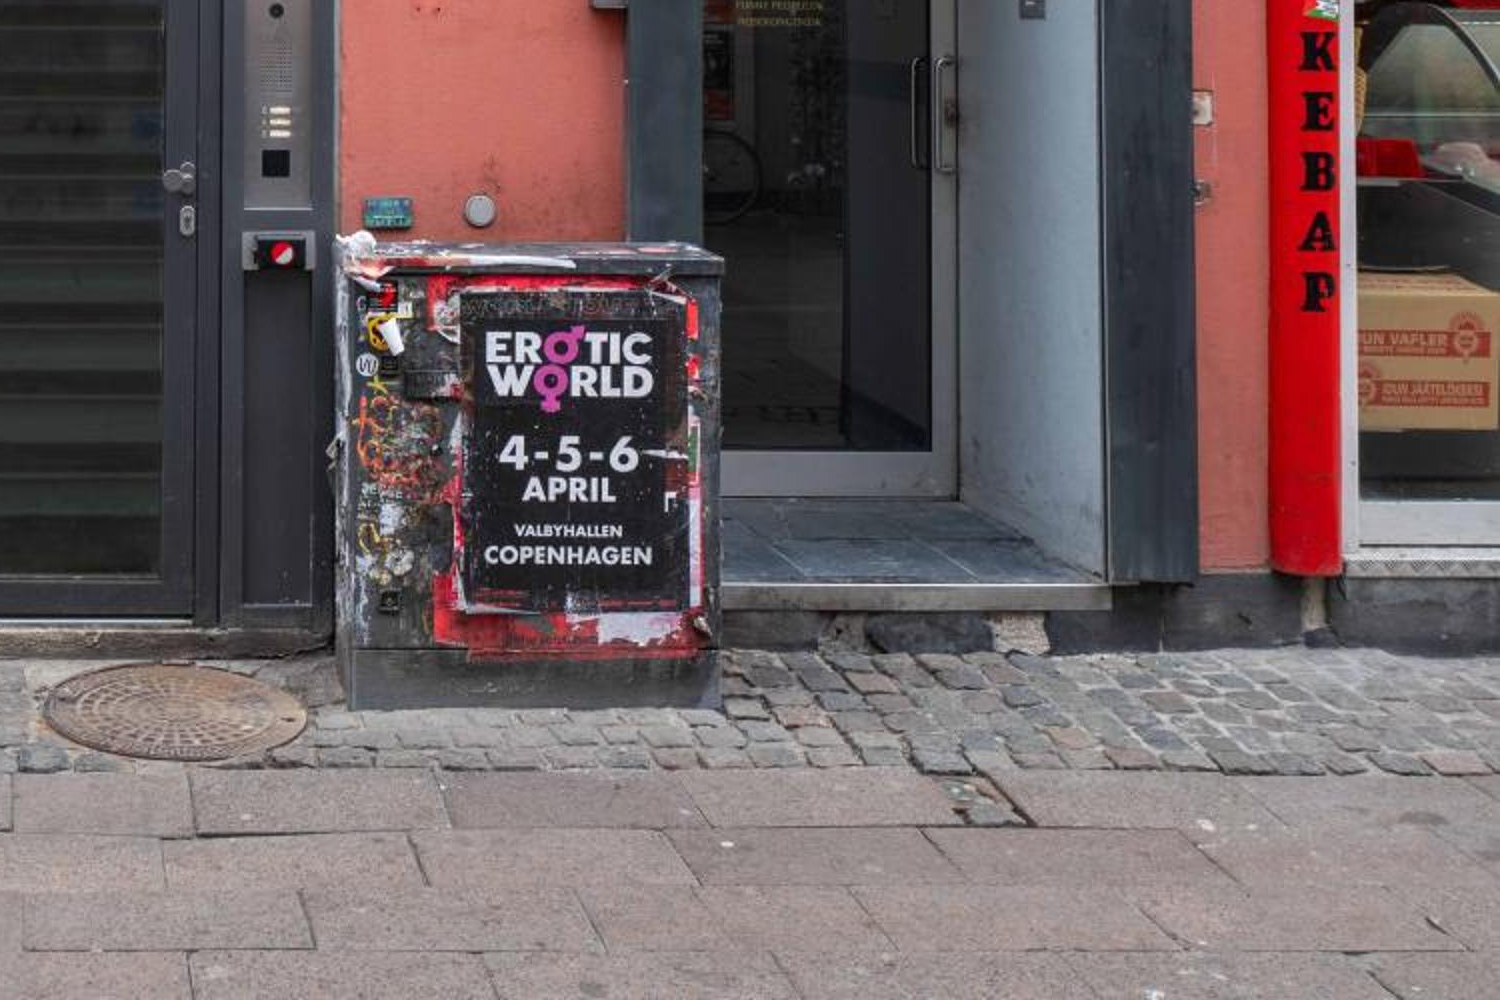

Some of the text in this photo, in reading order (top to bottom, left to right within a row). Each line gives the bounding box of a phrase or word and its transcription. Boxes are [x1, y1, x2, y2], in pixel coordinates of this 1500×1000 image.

[1297, 31, 1337, 313] KEBAP
[485, 325, 653, 364] EROTIC
[486, 364, 654, 406] WORLD
[522, 477, 617, 502] APRIL
[514, 524, 623, 538] VALBYHALLEN
[484, 545, 653, 566] COPENHAGEN
